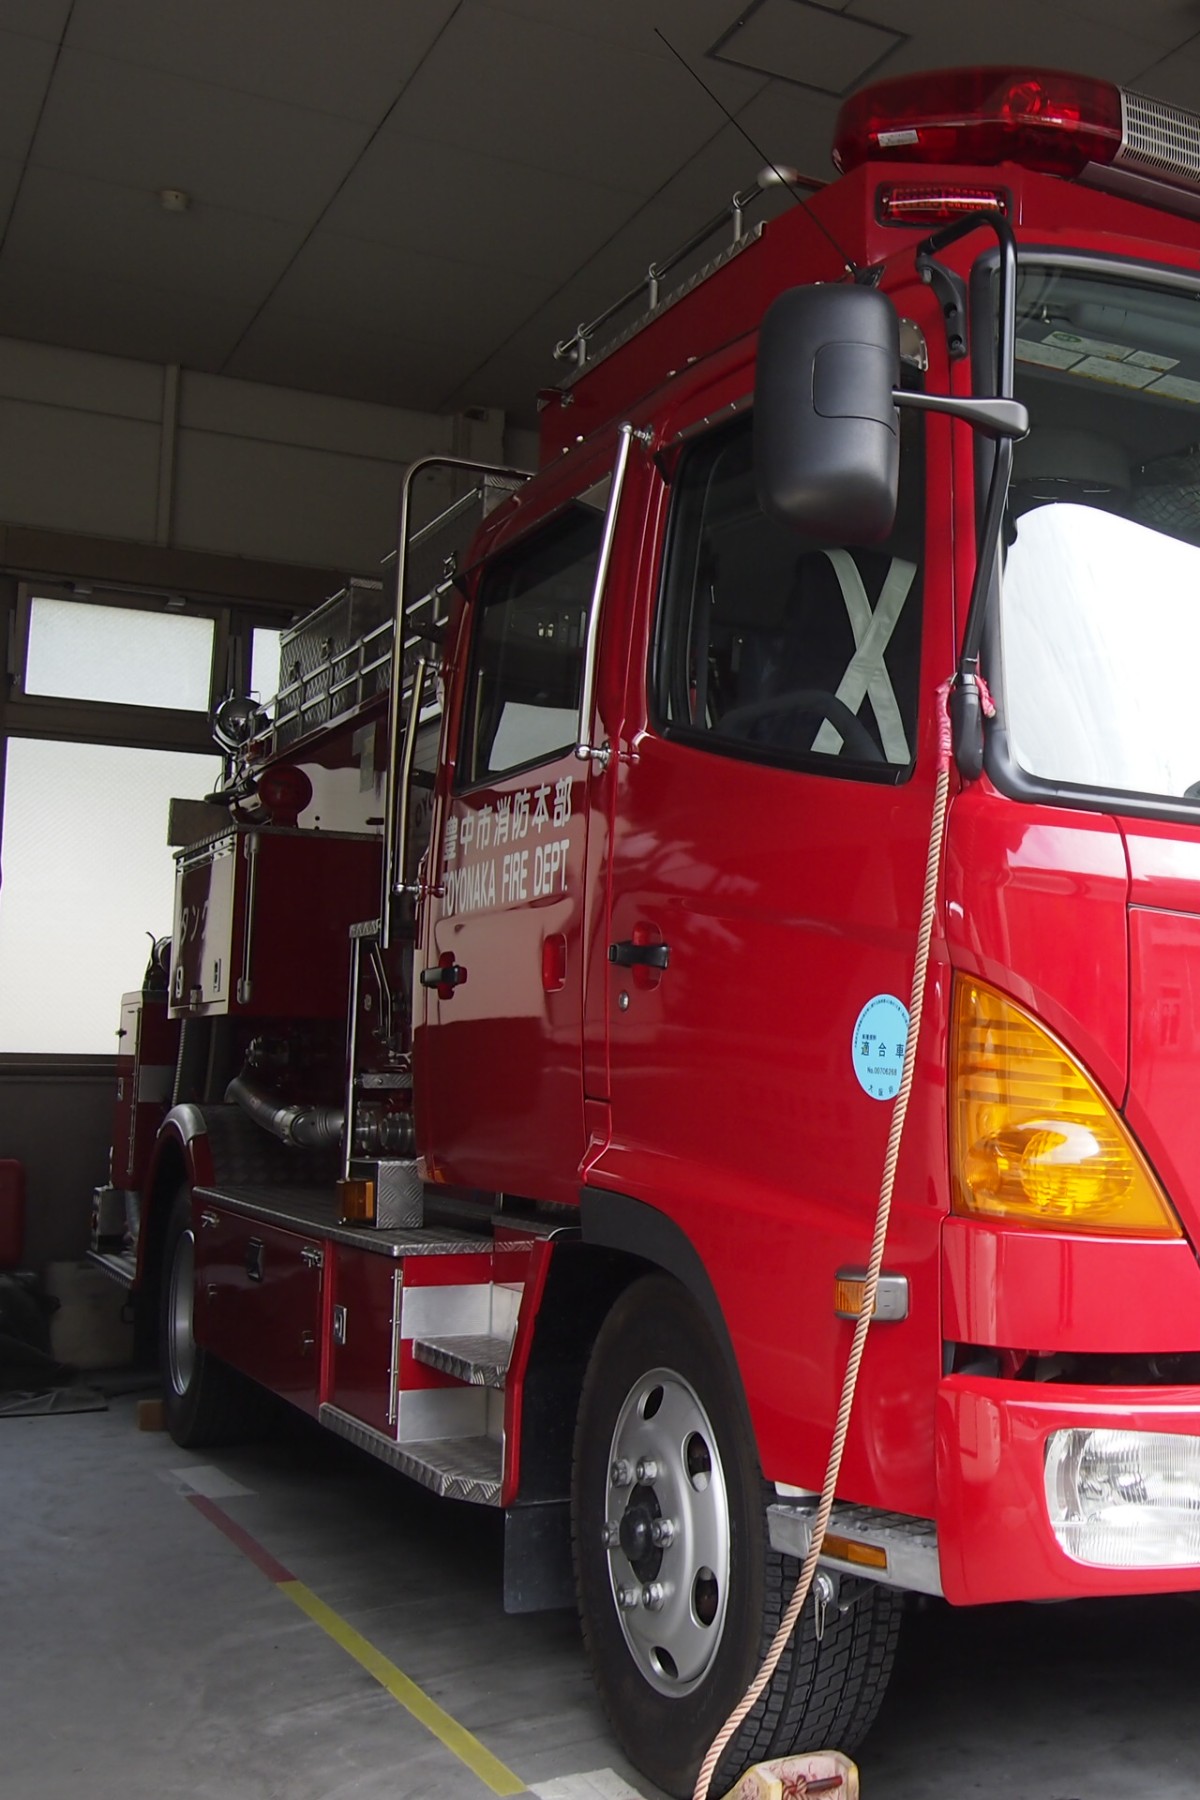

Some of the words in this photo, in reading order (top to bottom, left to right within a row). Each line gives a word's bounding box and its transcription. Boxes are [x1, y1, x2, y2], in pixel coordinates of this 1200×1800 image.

[443, 776, 573, 860] 豊中市消防本部
[442, 859, 496, 917] TOYONAKA
[502, 850, 528, 903] FIRE
